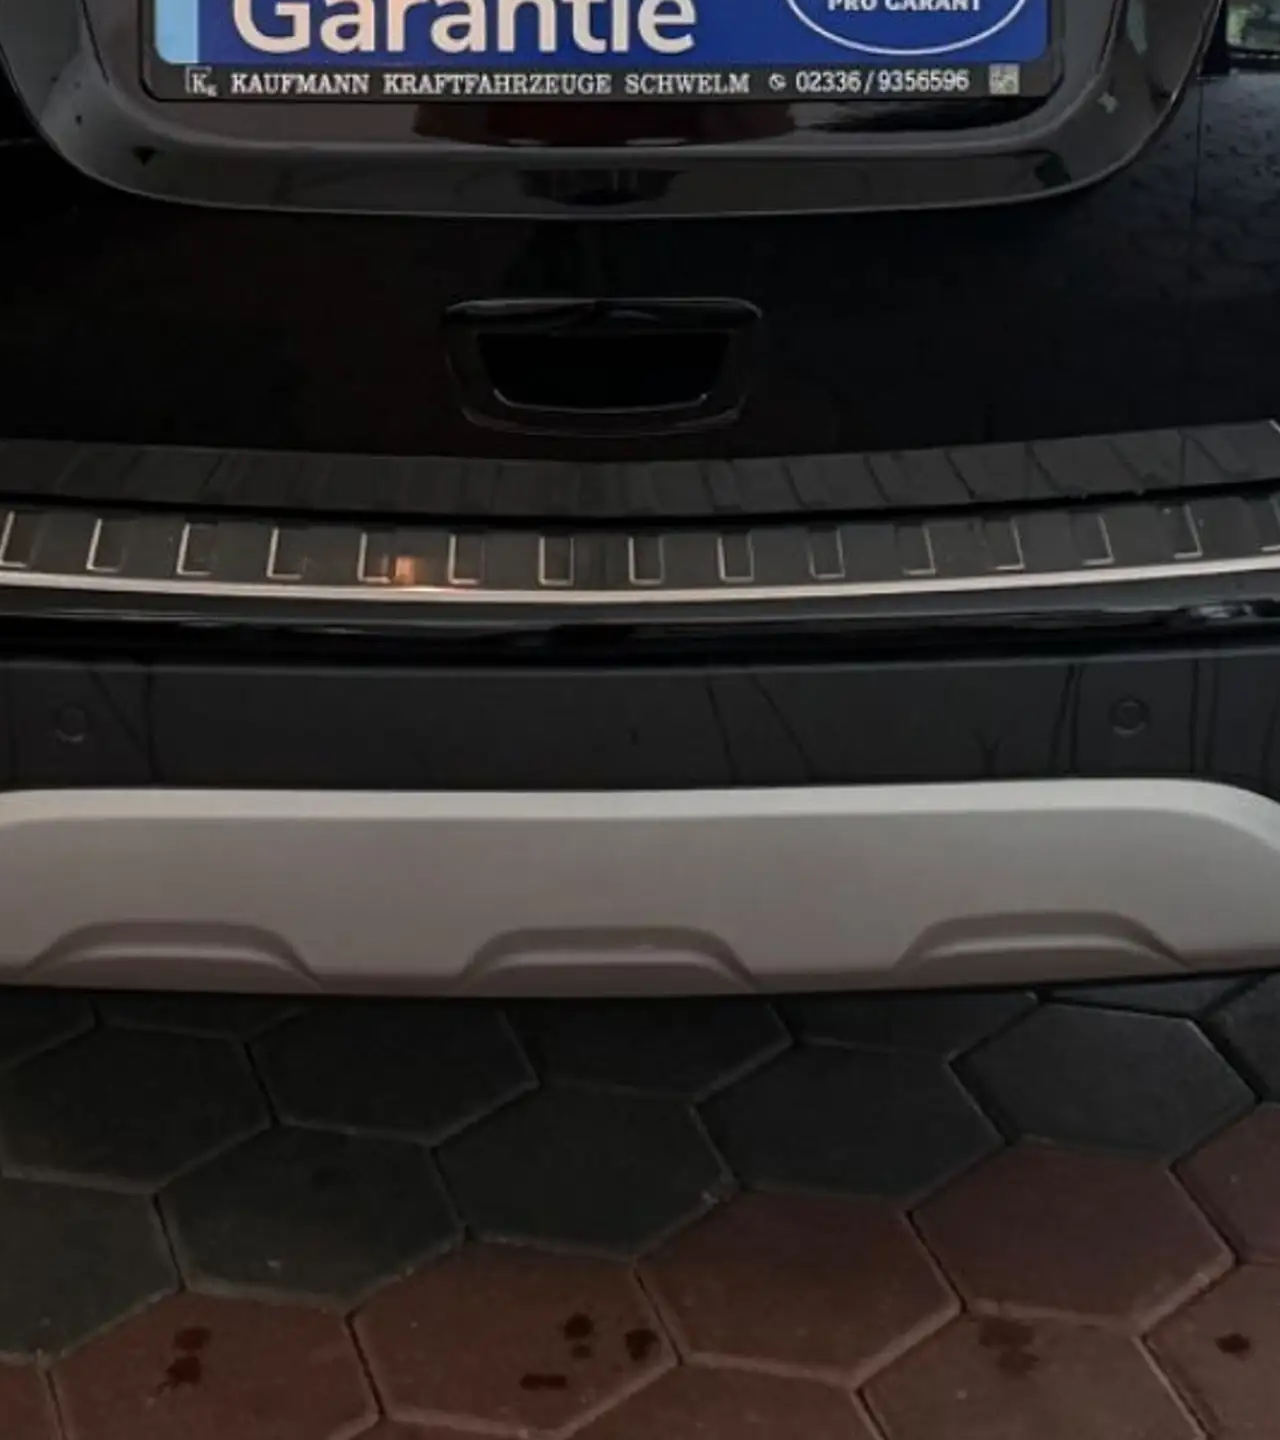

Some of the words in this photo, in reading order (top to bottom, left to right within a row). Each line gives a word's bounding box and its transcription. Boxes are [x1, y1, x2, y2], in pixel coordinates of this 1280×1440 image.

[230, 72, 371, 95] KAUFMANN
[382, 72, 612, 95] KRAFTFAHRZEUGE
[624, 72, 751, 95] SCHWELM
